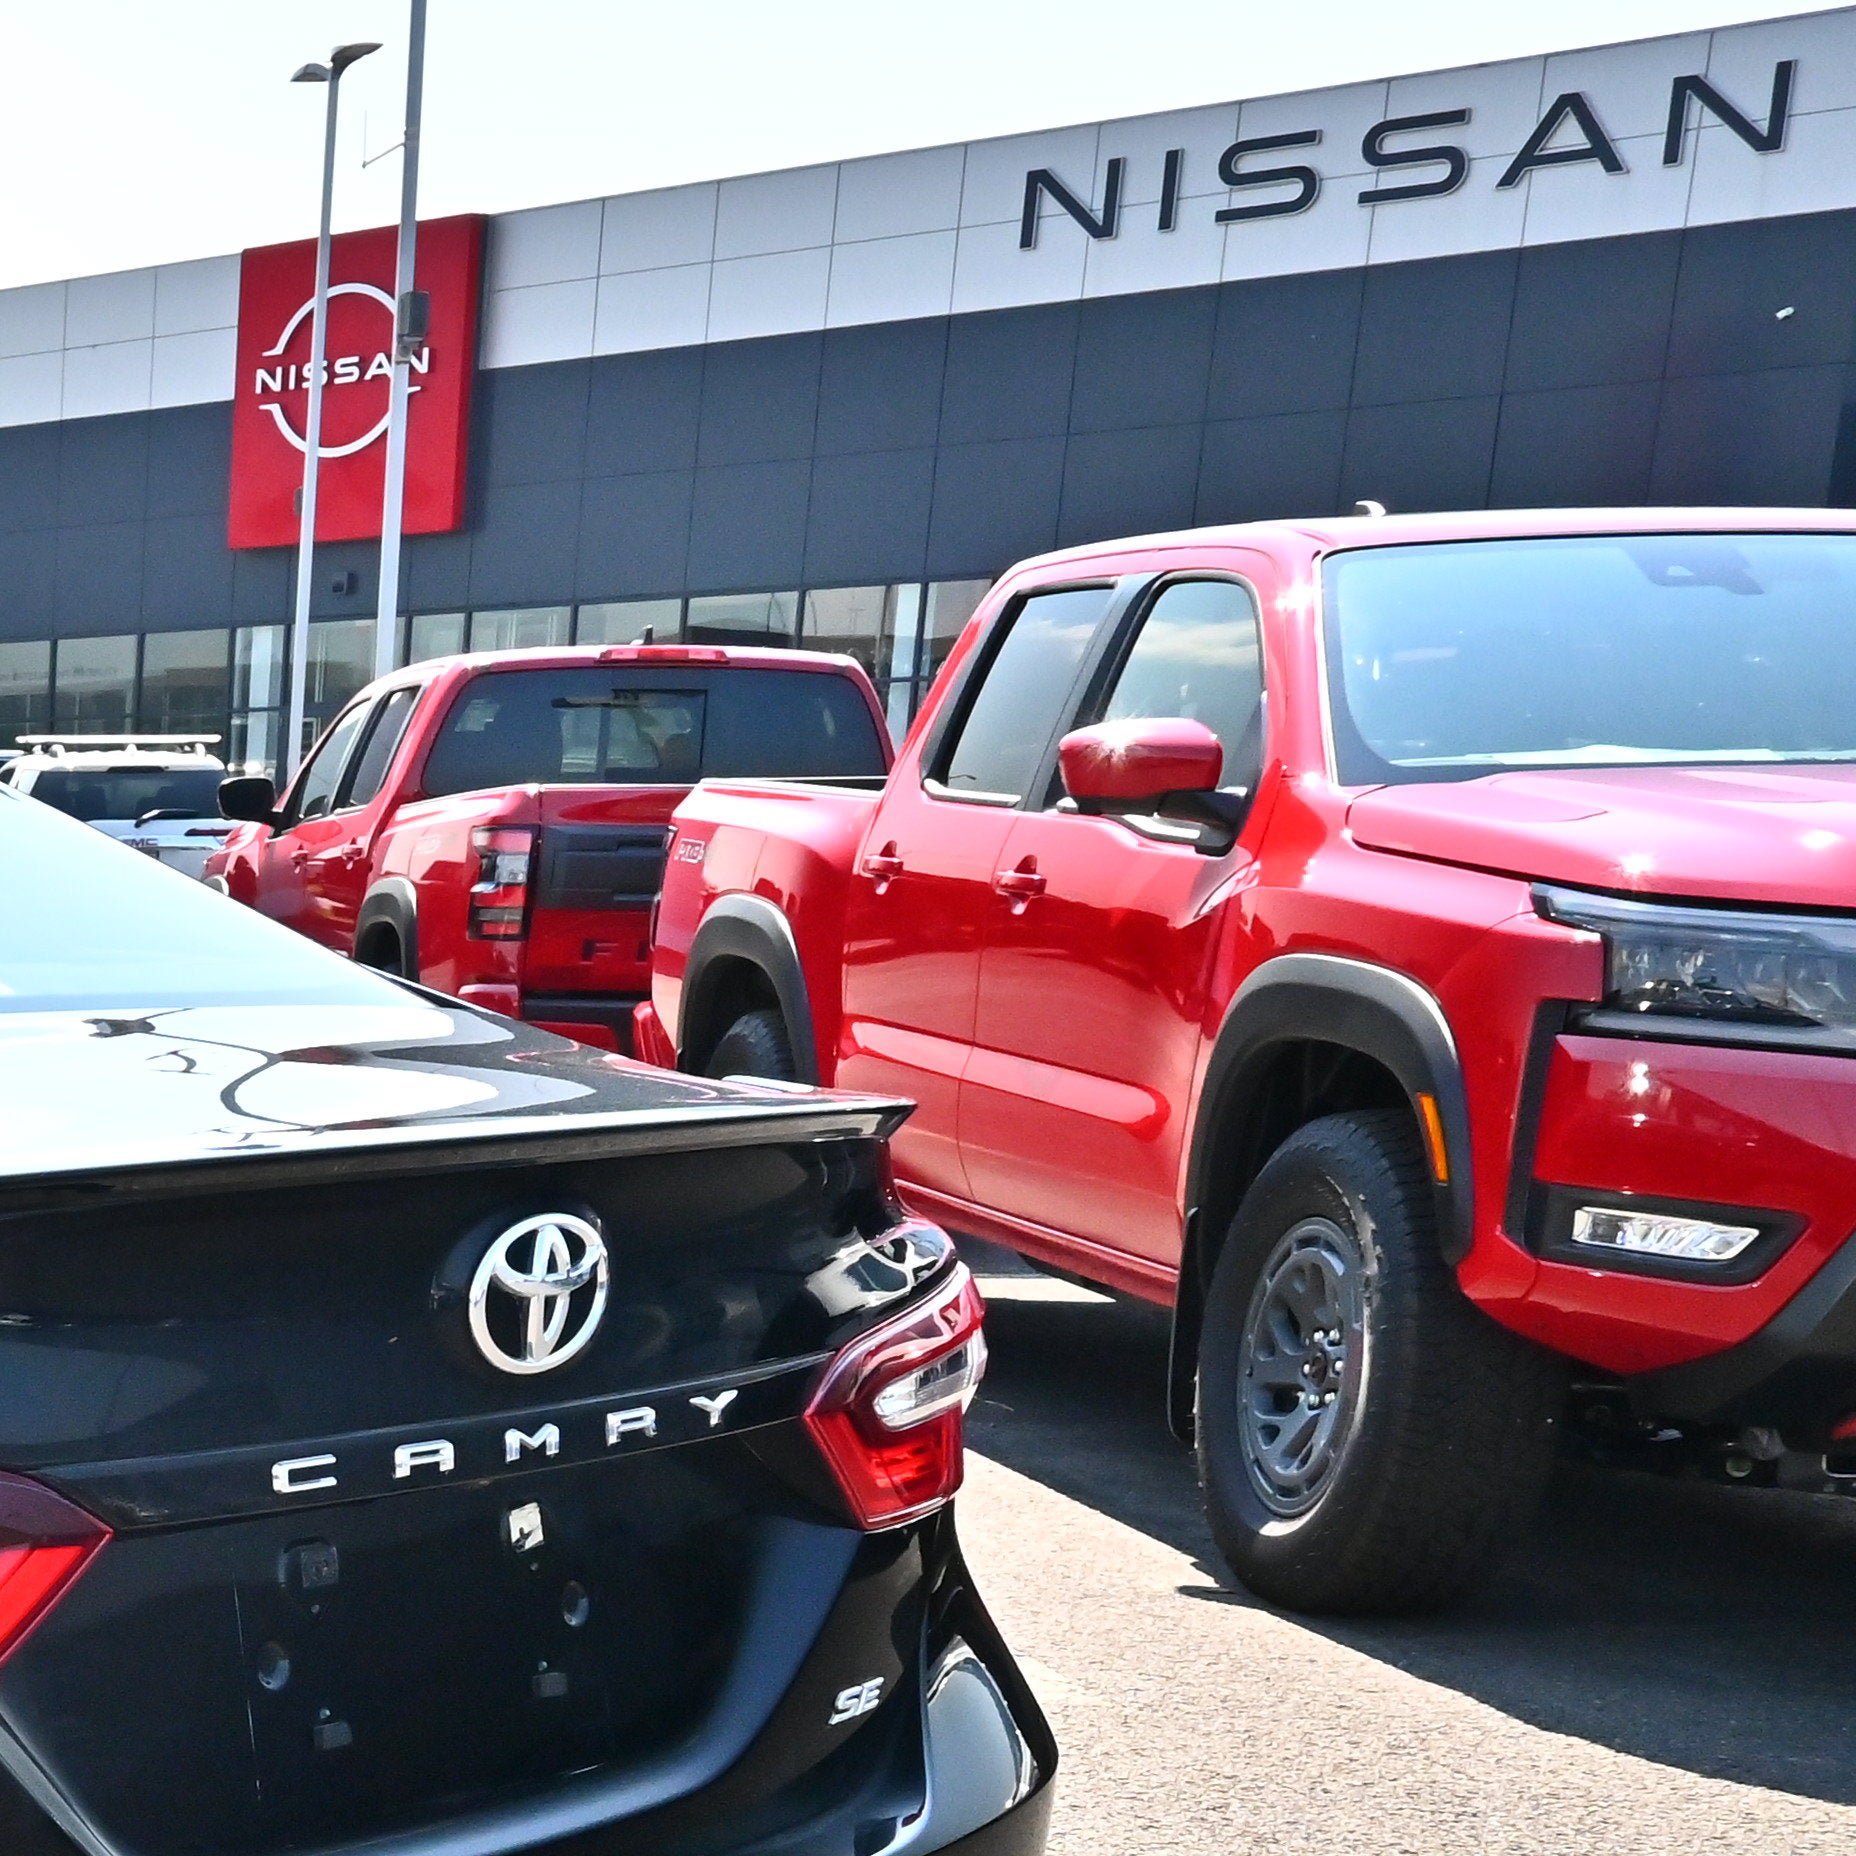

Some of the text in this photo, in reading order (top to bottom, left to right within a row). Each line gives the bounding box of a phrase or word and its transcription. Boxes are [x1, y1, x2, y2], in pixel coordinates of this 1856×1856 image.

[1019, 58, 1799, 251] NISSAN
[255, 346, 430, 395] NISSAN
[271, 1389, 738, 1495] CAMRY
[828, 1676, 885, 1727] SE
